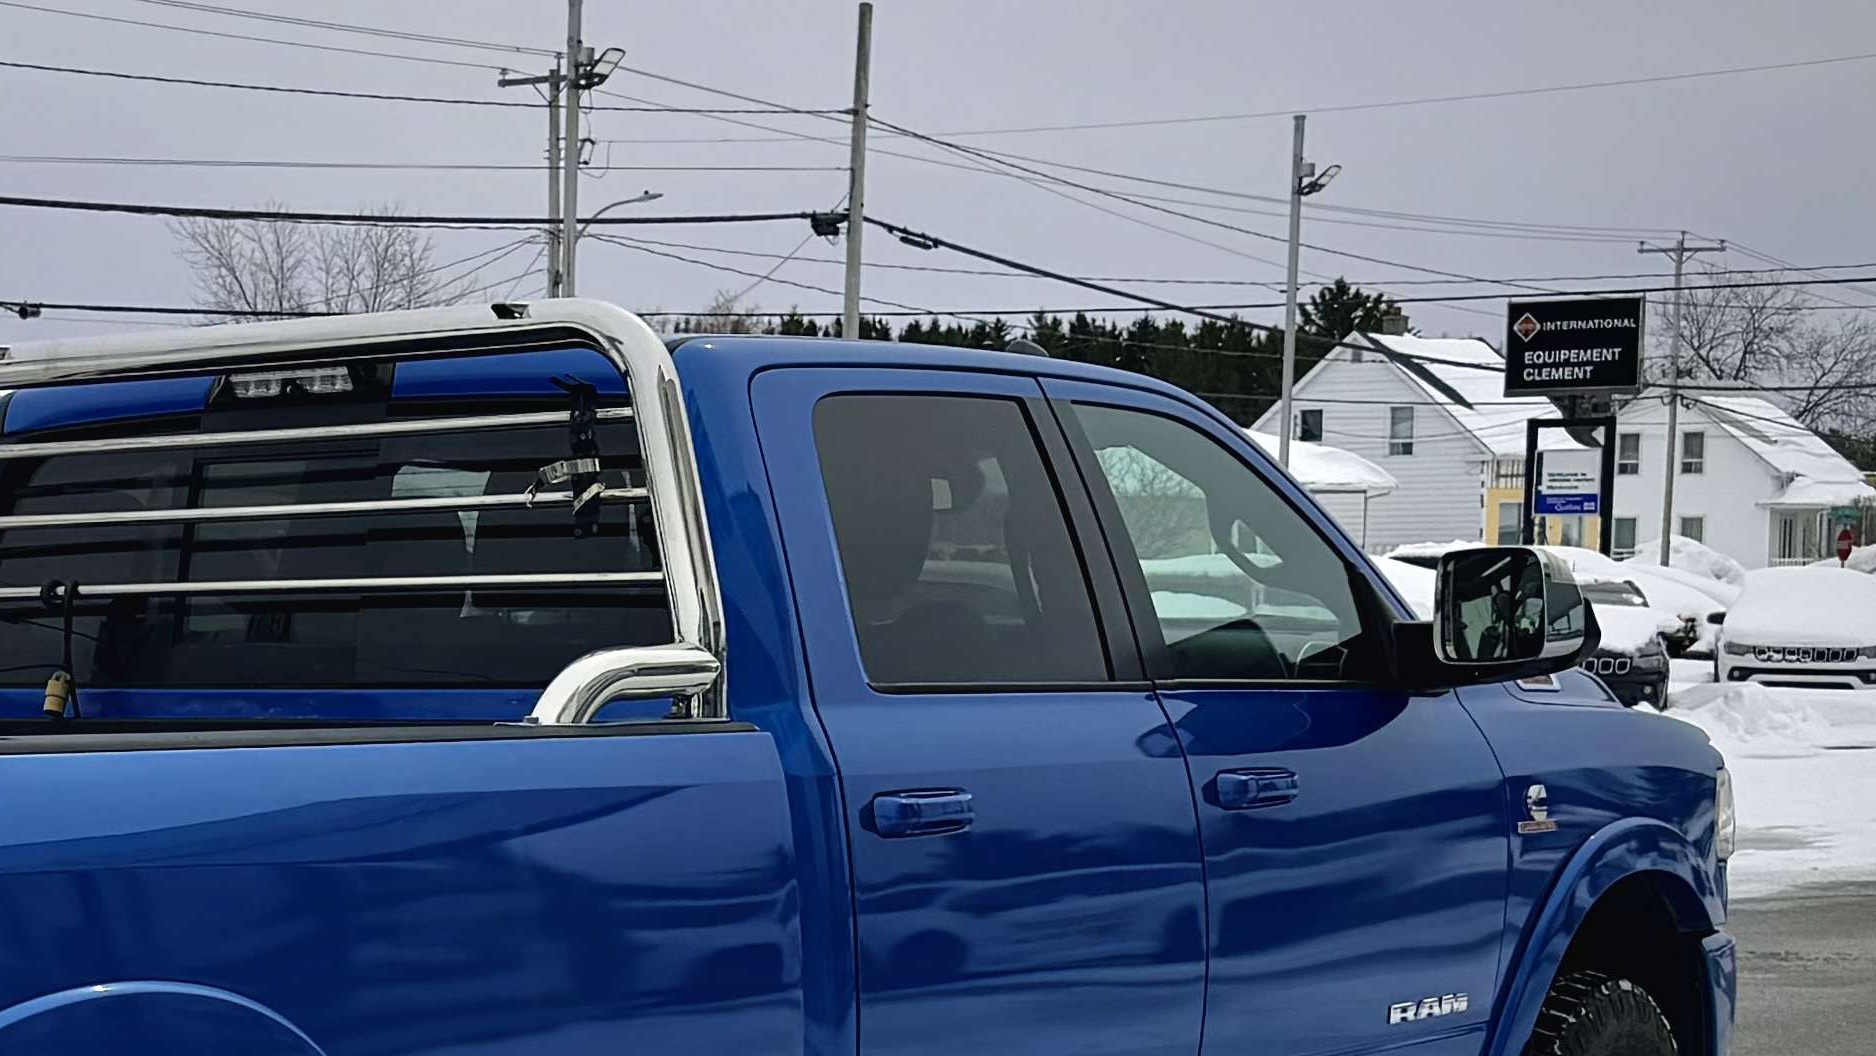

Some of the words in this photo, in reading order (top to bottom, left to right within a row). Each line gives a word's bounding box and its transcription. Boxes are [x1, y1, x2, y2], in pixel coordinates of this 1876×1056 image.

[1542, 318, 1637, 331] INTERNATIONAL
[1524, 347, 1622, 364] EQUIPEMENT
[1523, 366, 1594, 381] CLEMENT
[1388, 993, 1468, 1024] RAM
